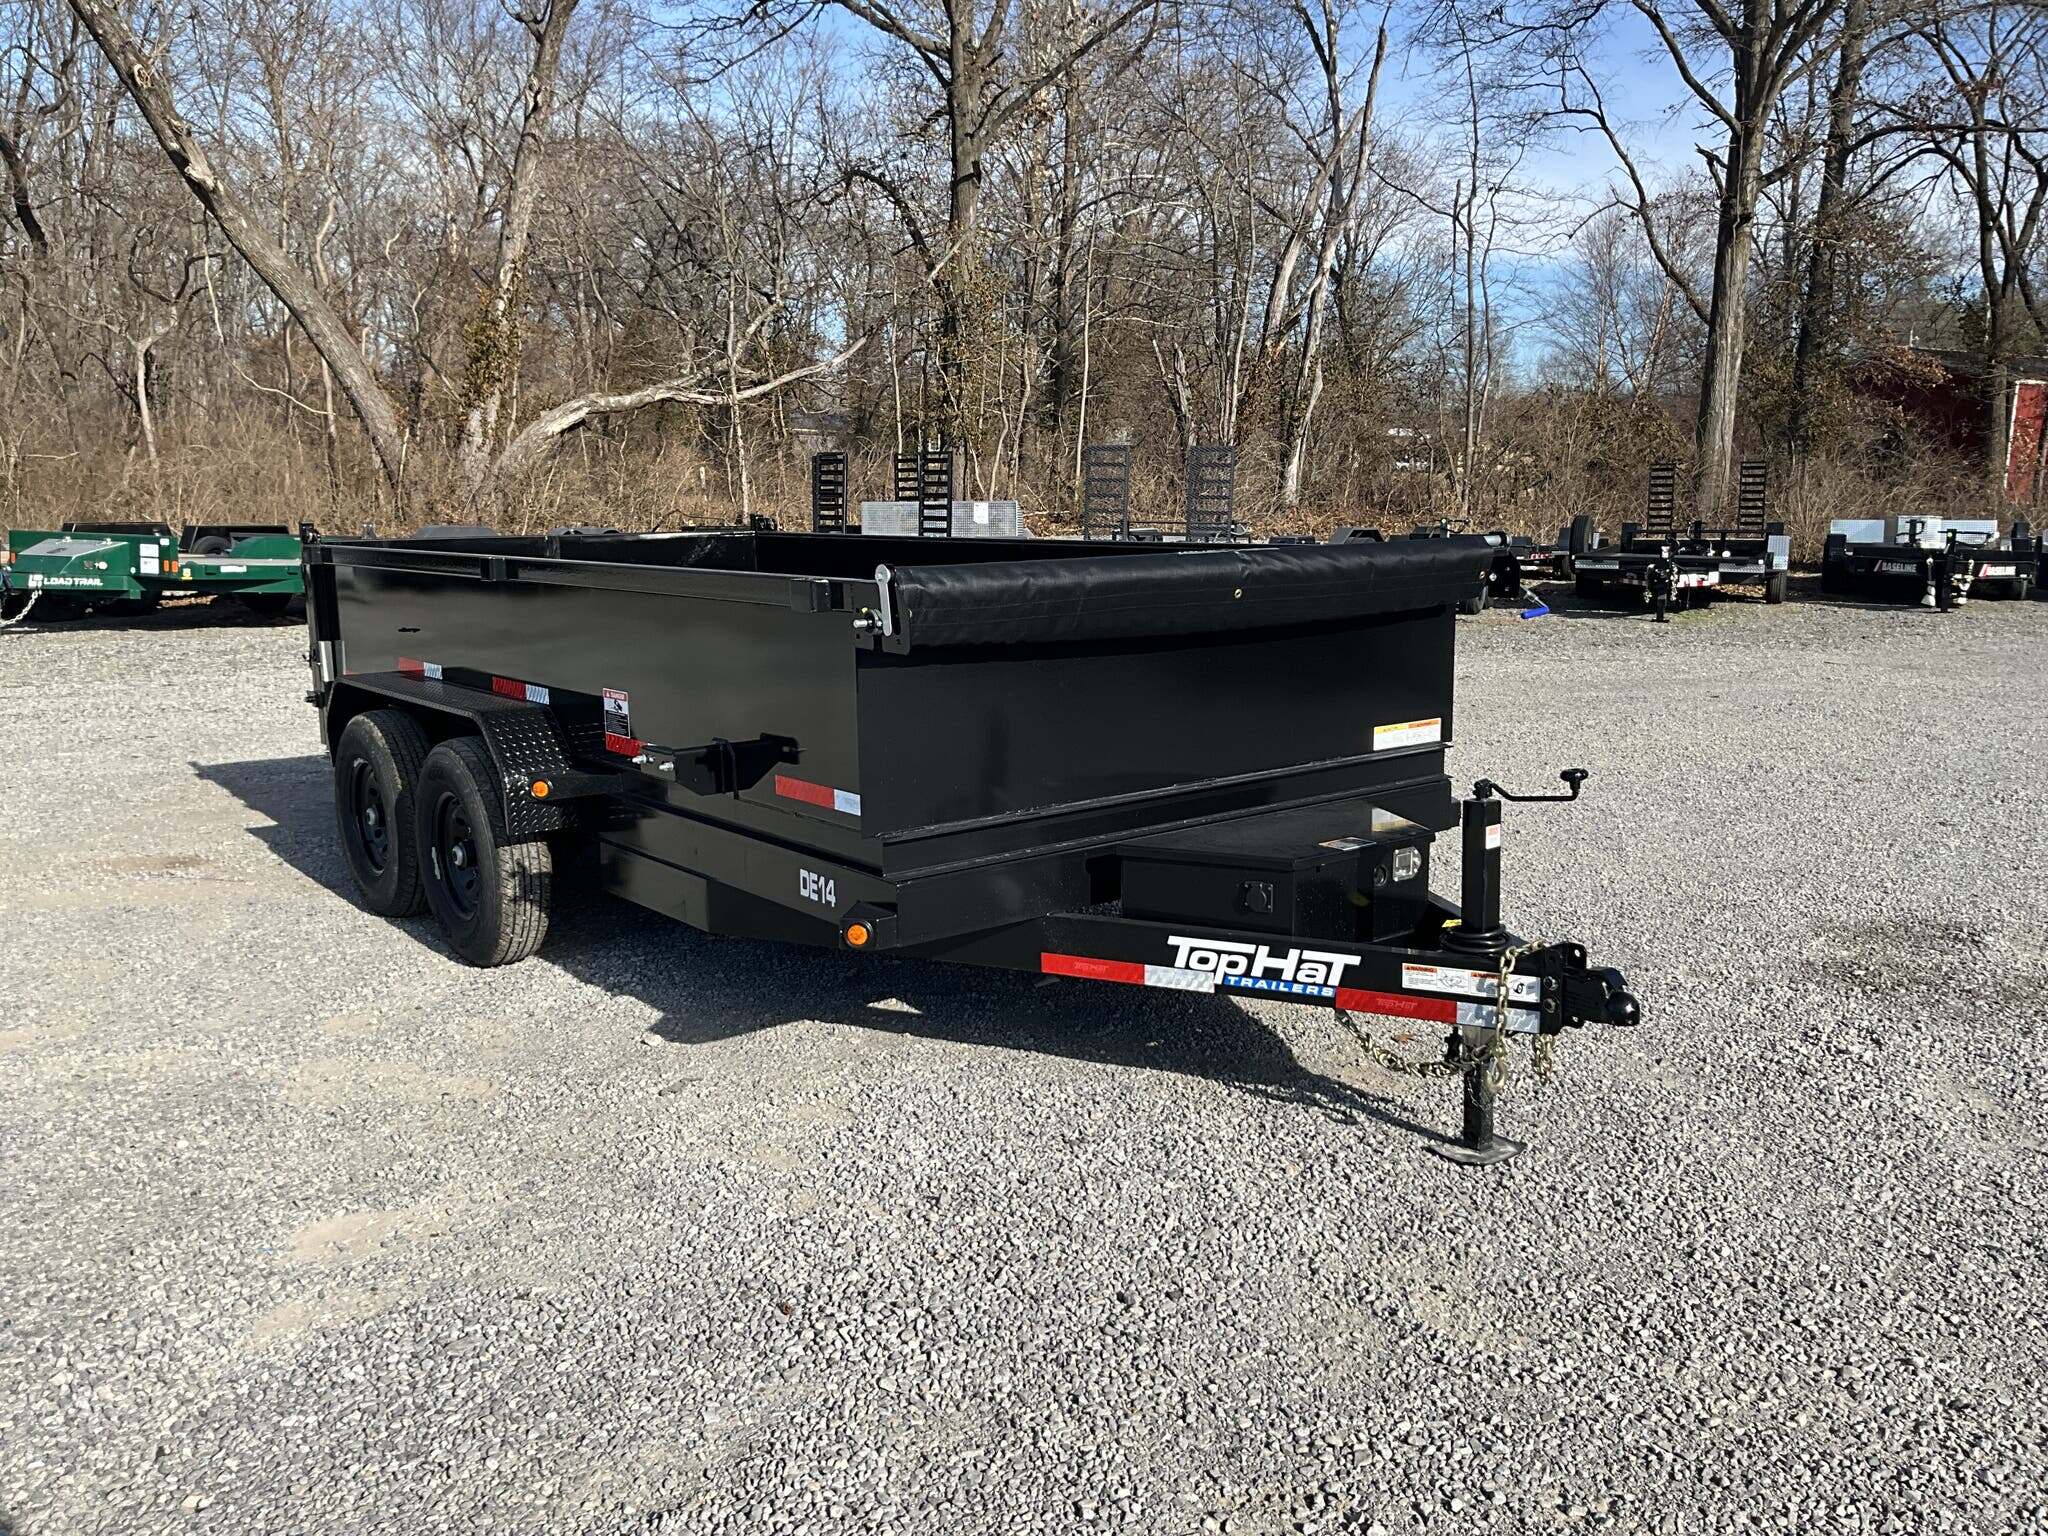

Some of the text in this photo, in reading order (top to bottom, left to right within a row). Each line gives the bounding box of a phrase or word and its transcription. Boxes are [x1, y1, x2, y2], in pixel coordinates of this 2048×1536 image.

[1881, 561, 1918, 573] BASELINE
[44, 577, 73, 585] LOAD
[73, 577, 104, 586] TRAIL
[800, 868, 836, 907] DE14
[1227, 975, 1335, 997] TRAILERS
